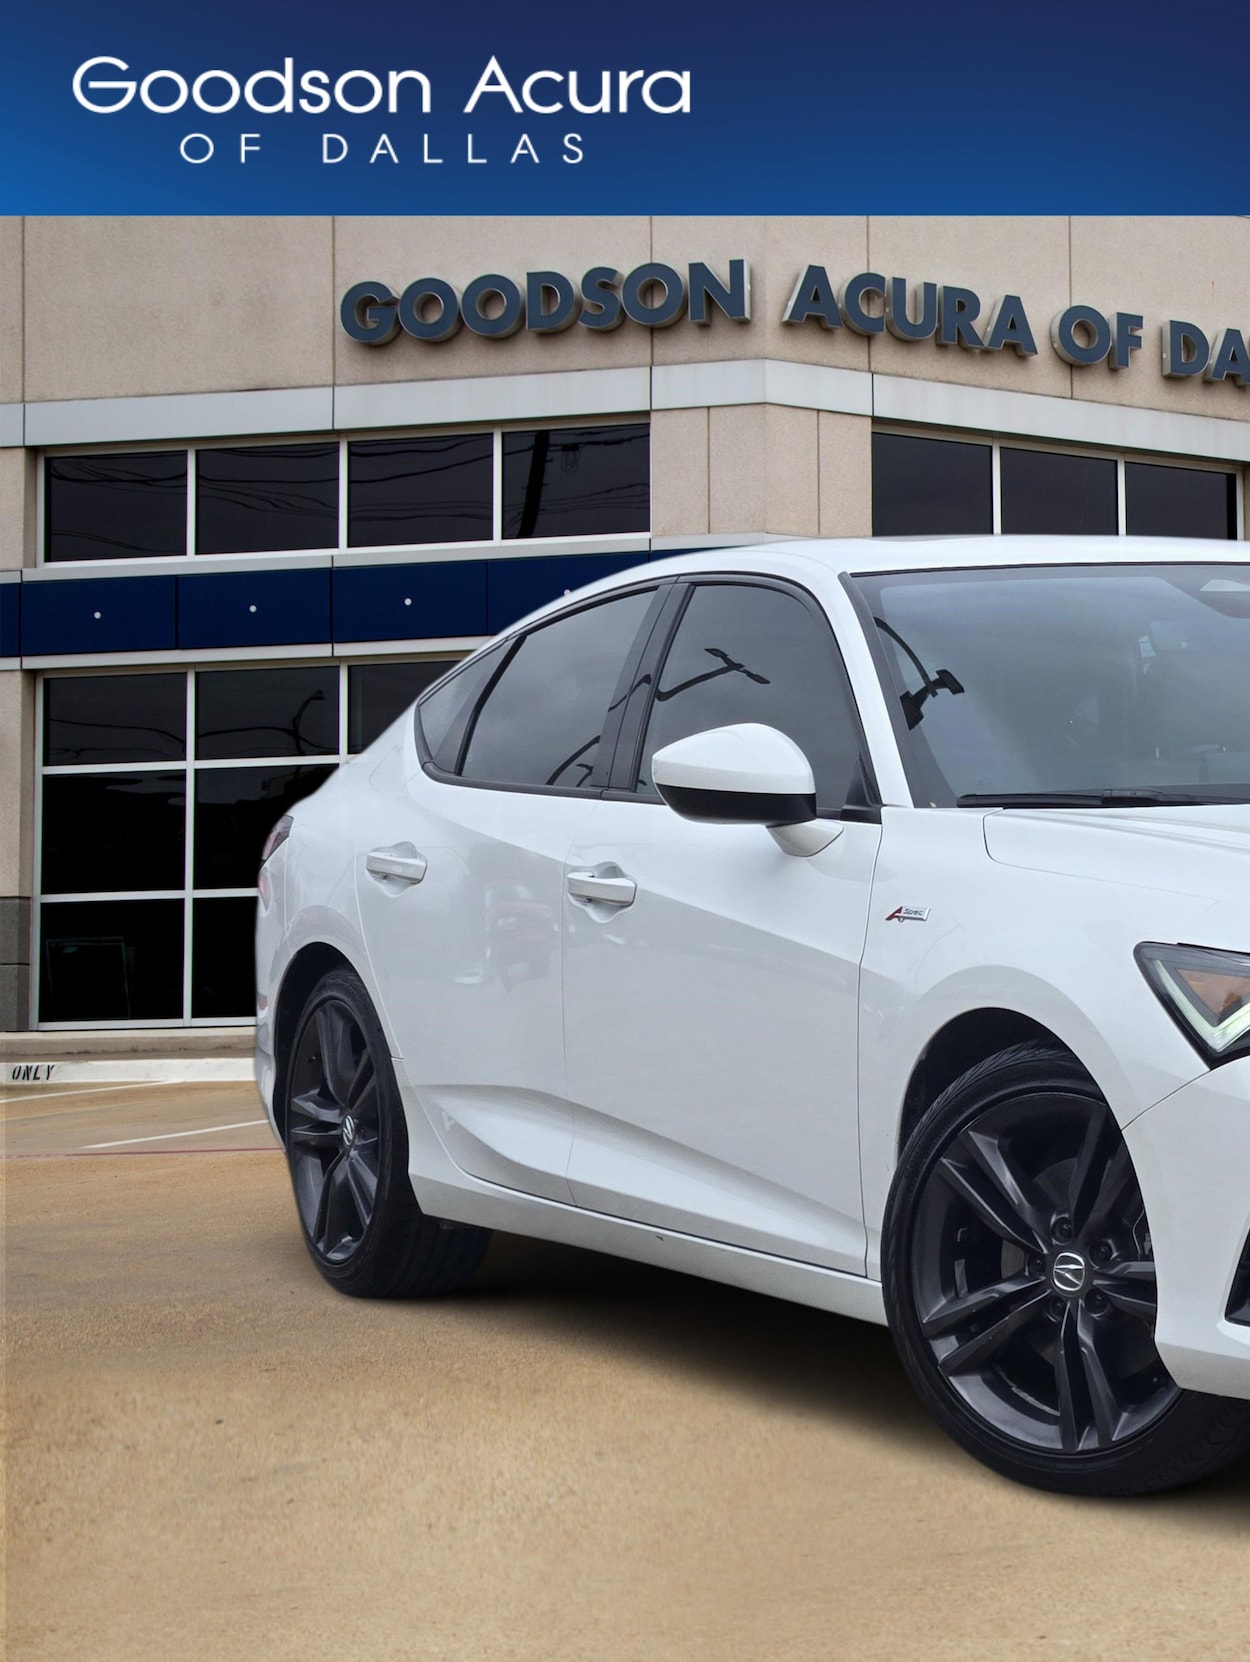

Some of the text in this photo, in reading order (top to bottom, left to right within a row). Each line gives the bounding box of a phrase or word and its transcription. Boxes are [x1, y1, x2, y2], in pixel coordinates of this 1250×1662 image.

[339, 258, 751, 346] GOODSON
[781, 264, 1038, 357] ACURA
[1051, 305, 1143, 370] OF
[11, 1064, 56, 1081] ONLY
